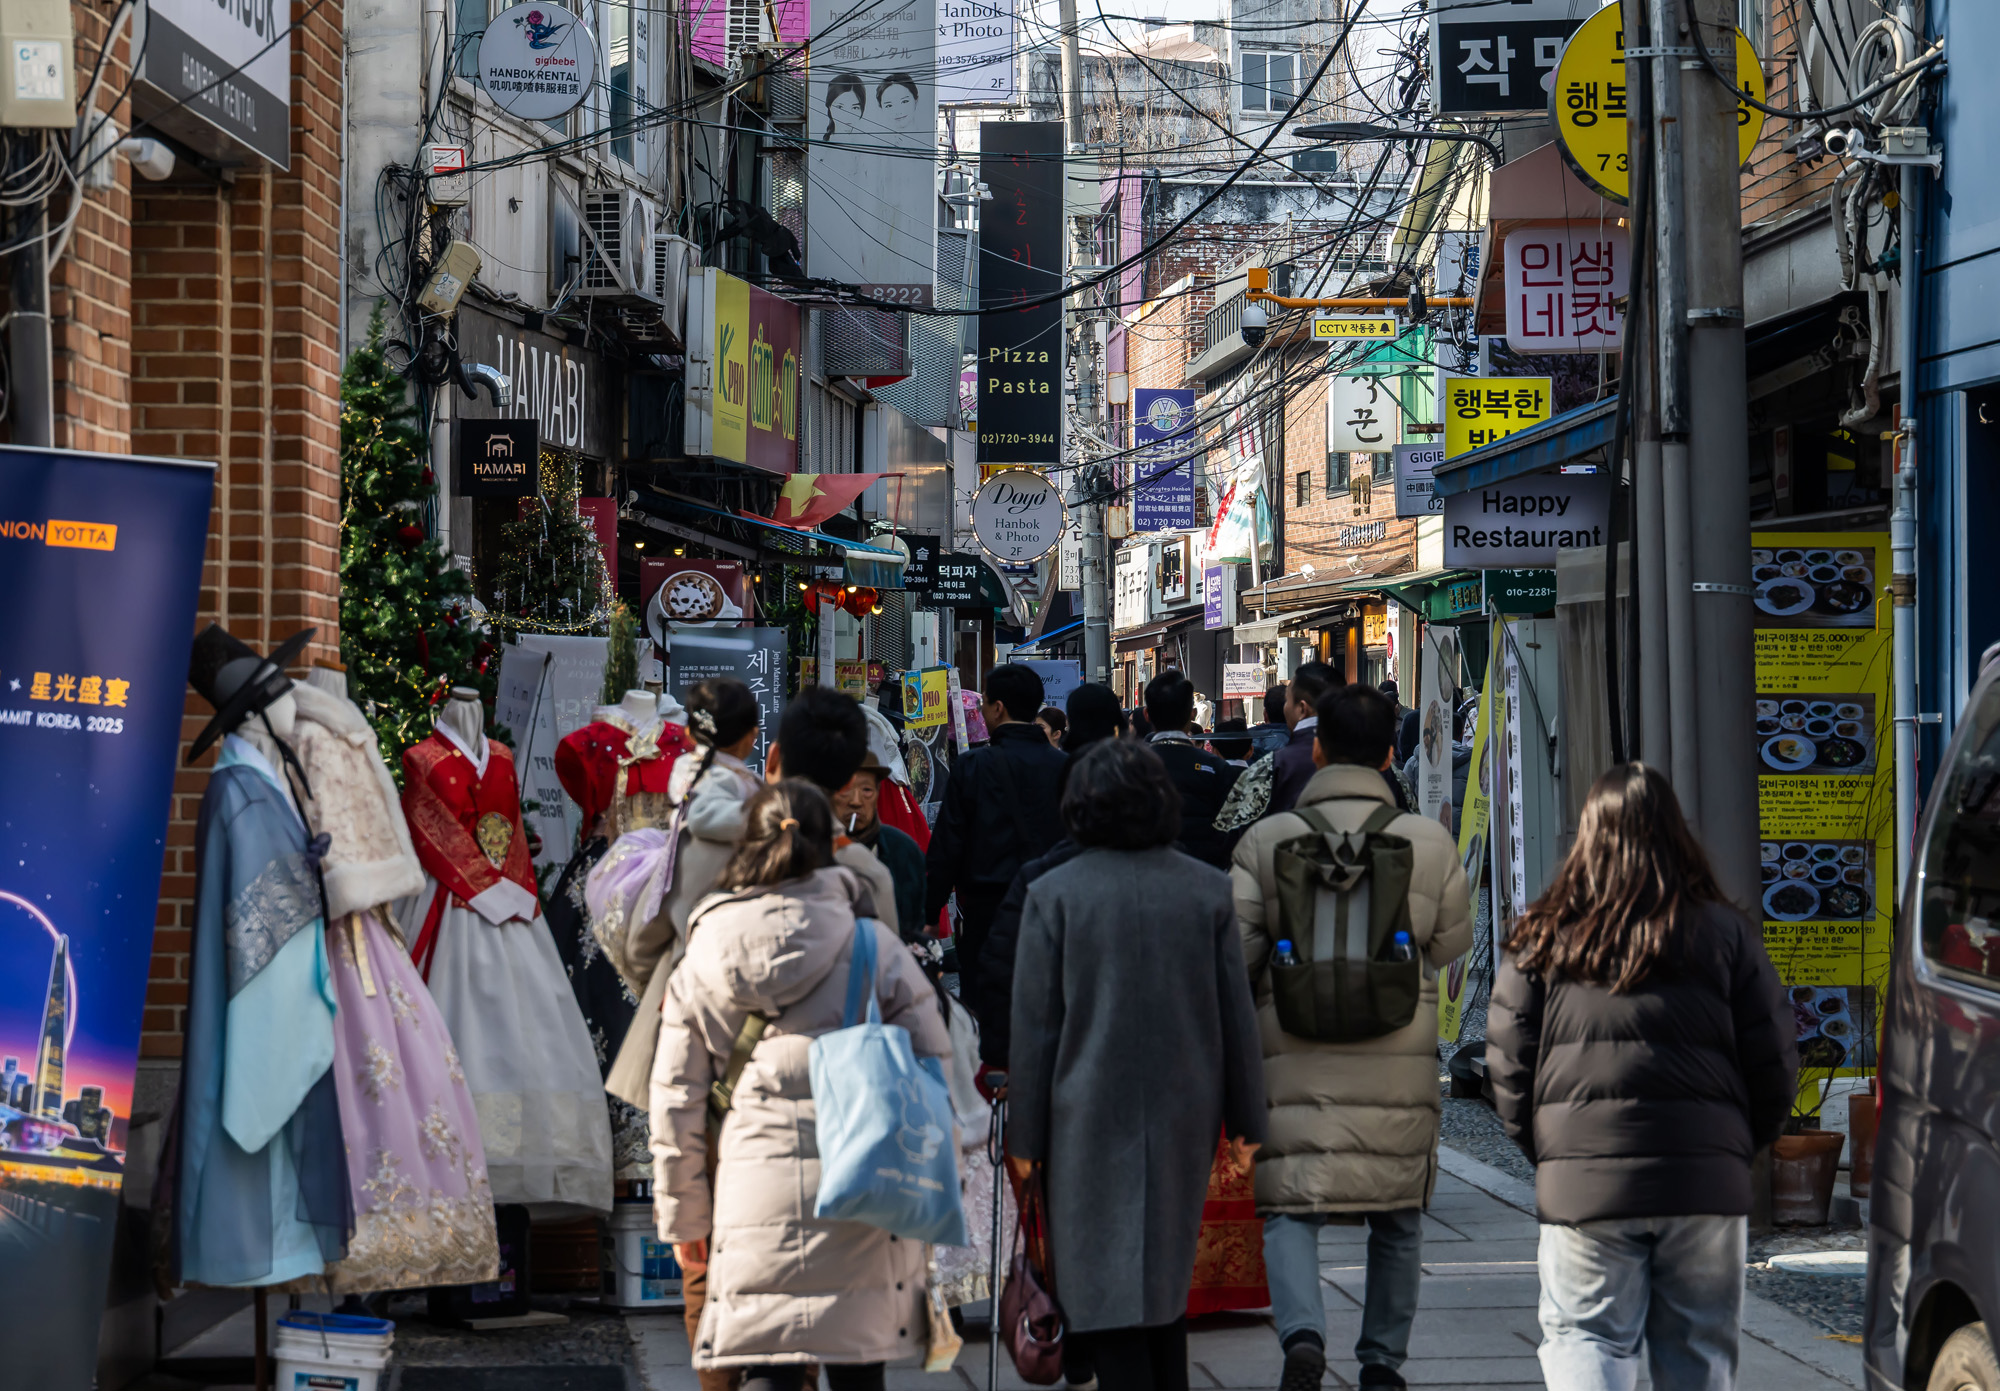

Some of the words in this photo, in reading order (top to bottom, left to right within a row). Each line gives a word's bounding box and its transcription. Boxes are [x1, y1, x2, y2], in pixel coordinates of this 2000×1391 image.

[829, 10, 876, 21] hanbok
[882, 10, 916, 21] rental
[954, 23, 1003, 37] Photo
[535, 56, 576, 67] gigibebe
[489, 67, 535, 80] HANBOK
[537, 70, 580, 82] RENTAL
[991, 77, 1006, 88] 2F
[1520, 241, 1614, 288] 인생
[1521, 292, 1616, 337] 네컷
[1319, 324, 1347, 334] CCTV
[1350, 323, 1376, 333] 작동중
[989, 347, 1049, 363] Pizza
[497, 334, 585, 449] HAMABI
[728, 360, 744, 407] PHO
[988, 378, 1050, 394] Pasta
[1453, 389, 1543, 419] 행복한
[981, 433, 1054, 444] 02)720-3944
[473, 463, 526, 475] HAMABI
[1482, 490, 1571, 516] Happy
[995, 518, 1040, 529] Hanbok
[1138, 518, 1150, 527] 02)
[1153, 518, 1168, 526] 720
[1171, 518, 1191, 526] 7890
[54, 525, 109, 544] YOTTA
[995, 532, 1002, 541] &
[1006, 531, 1040, 543] Photo
[1453, 525, 1601, 548] Restaurant
[916, 547, 929, 561] 솔
[1010, 546, 1023, 556] 2F
[772, 650, 781, 666] Jeju
[30, 671, 130, 708] 星光盛宴
[772, 667, 781, 696] Matcha
[773, 697, 781, 714] Latte
[922, 690, 940, 708] PHO
[36, 711, 82, 730] KOREA
[86, 715, 124, 734] 2025
